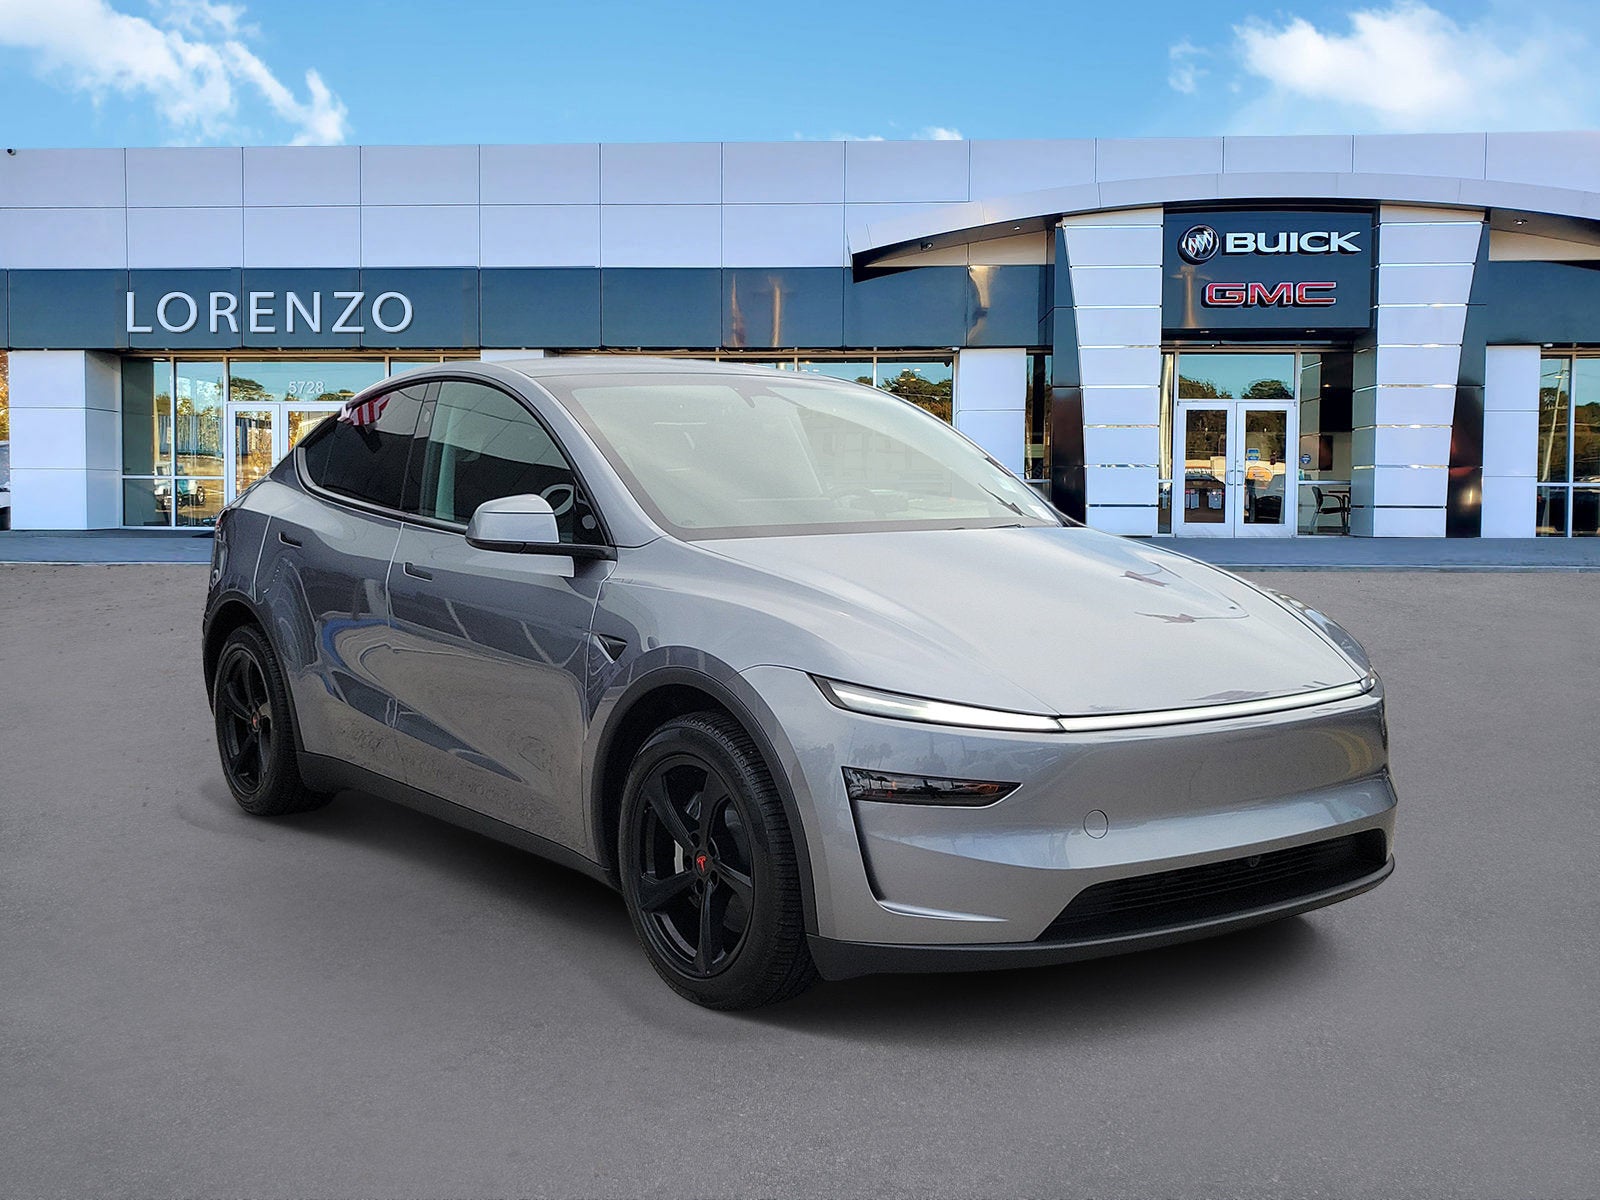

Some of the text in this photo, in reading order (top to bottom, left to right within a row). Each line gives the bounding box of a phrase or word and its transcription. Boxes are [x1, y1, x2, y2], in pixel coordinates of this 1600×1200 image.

[1226, 231, 1362, 253] BUICK
[1205, 281, 1337, 306] GMC
[126, 291, 414, 333] LORENZO
[288, 381, 325, 394] 5728
